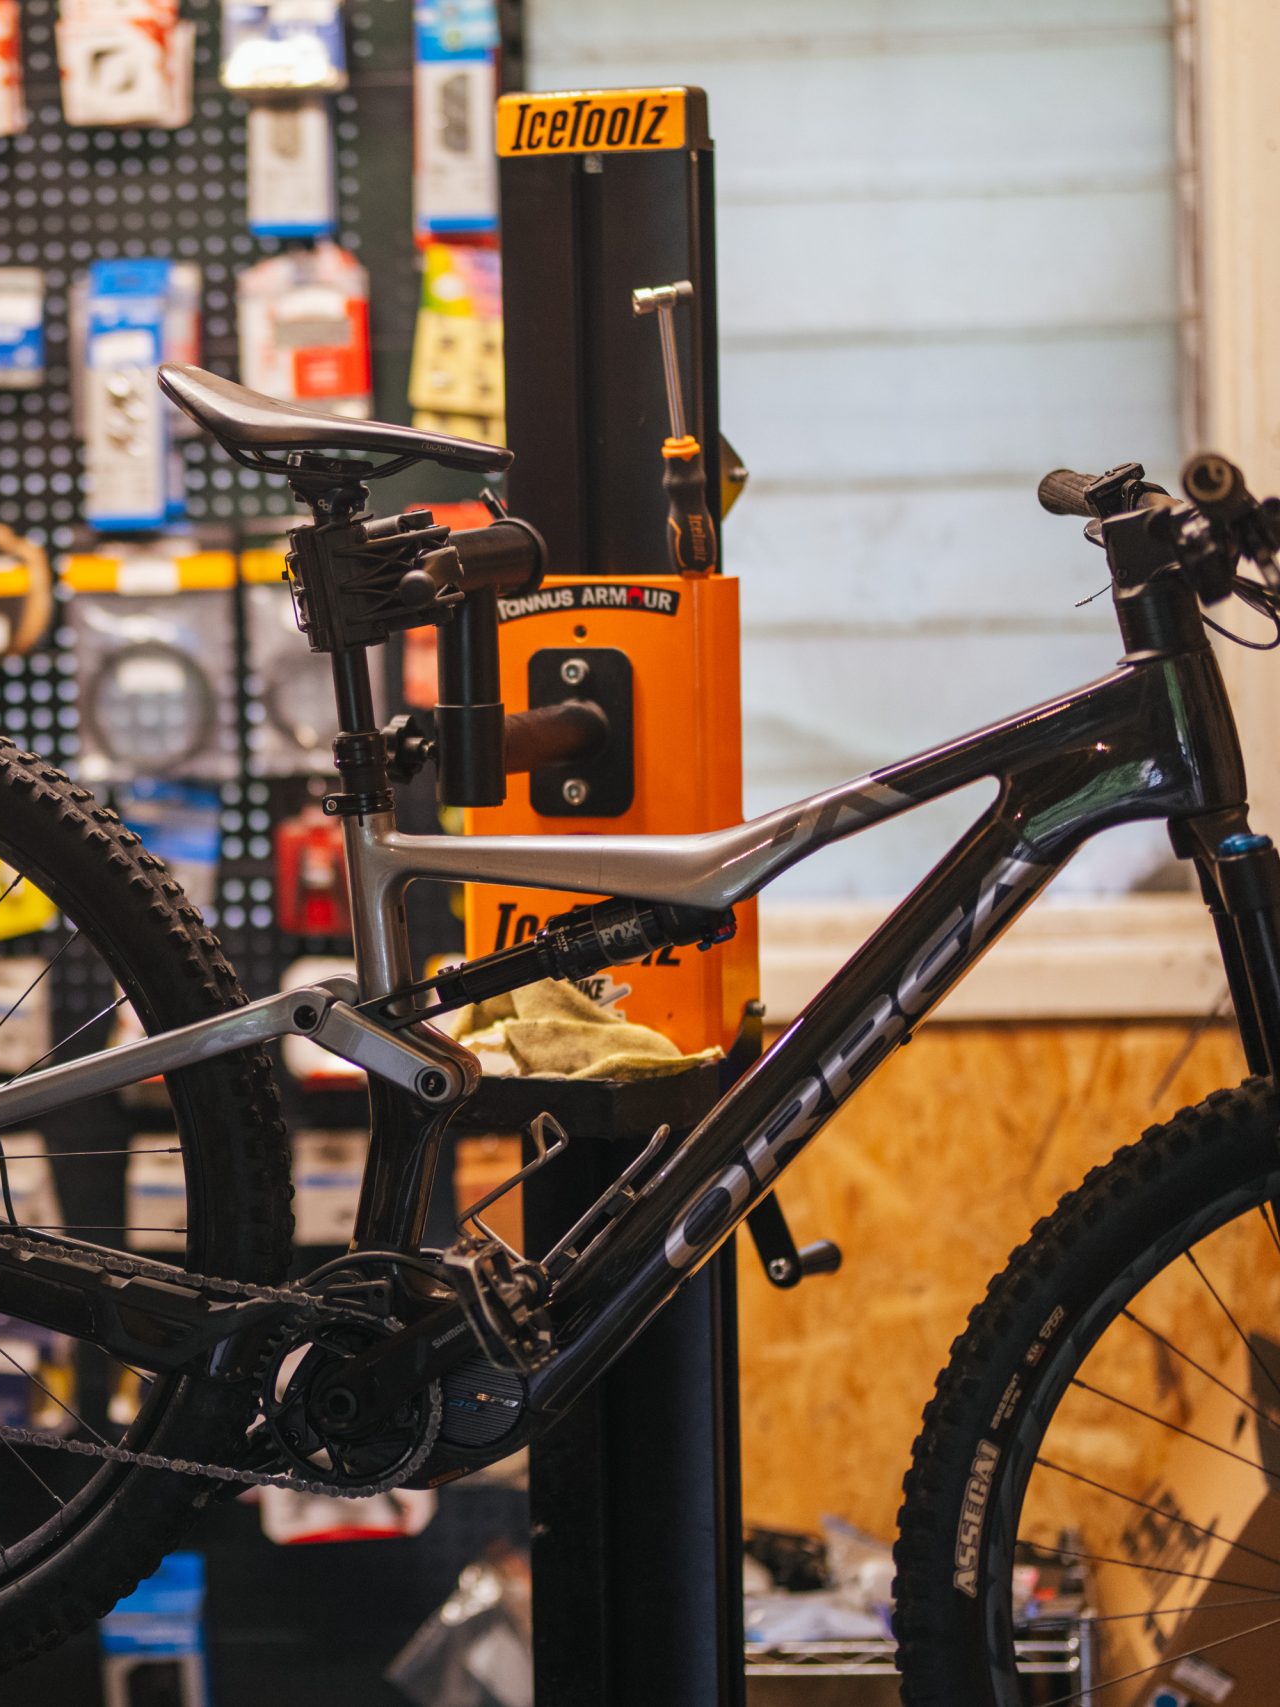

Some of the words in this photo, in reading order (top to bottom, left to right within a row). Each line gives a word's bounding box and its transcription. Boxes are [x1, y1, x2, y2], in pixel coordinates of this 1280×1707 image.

[510, 98, 670, 151] IceToolz
[599, 918, 641, 946] FOX
[664, 858, 1052, 1269] ORBEA
[431, 1320, 470, 1349] SHIMAN
[952, 1438, 1002, 1600] ASSEGAI
